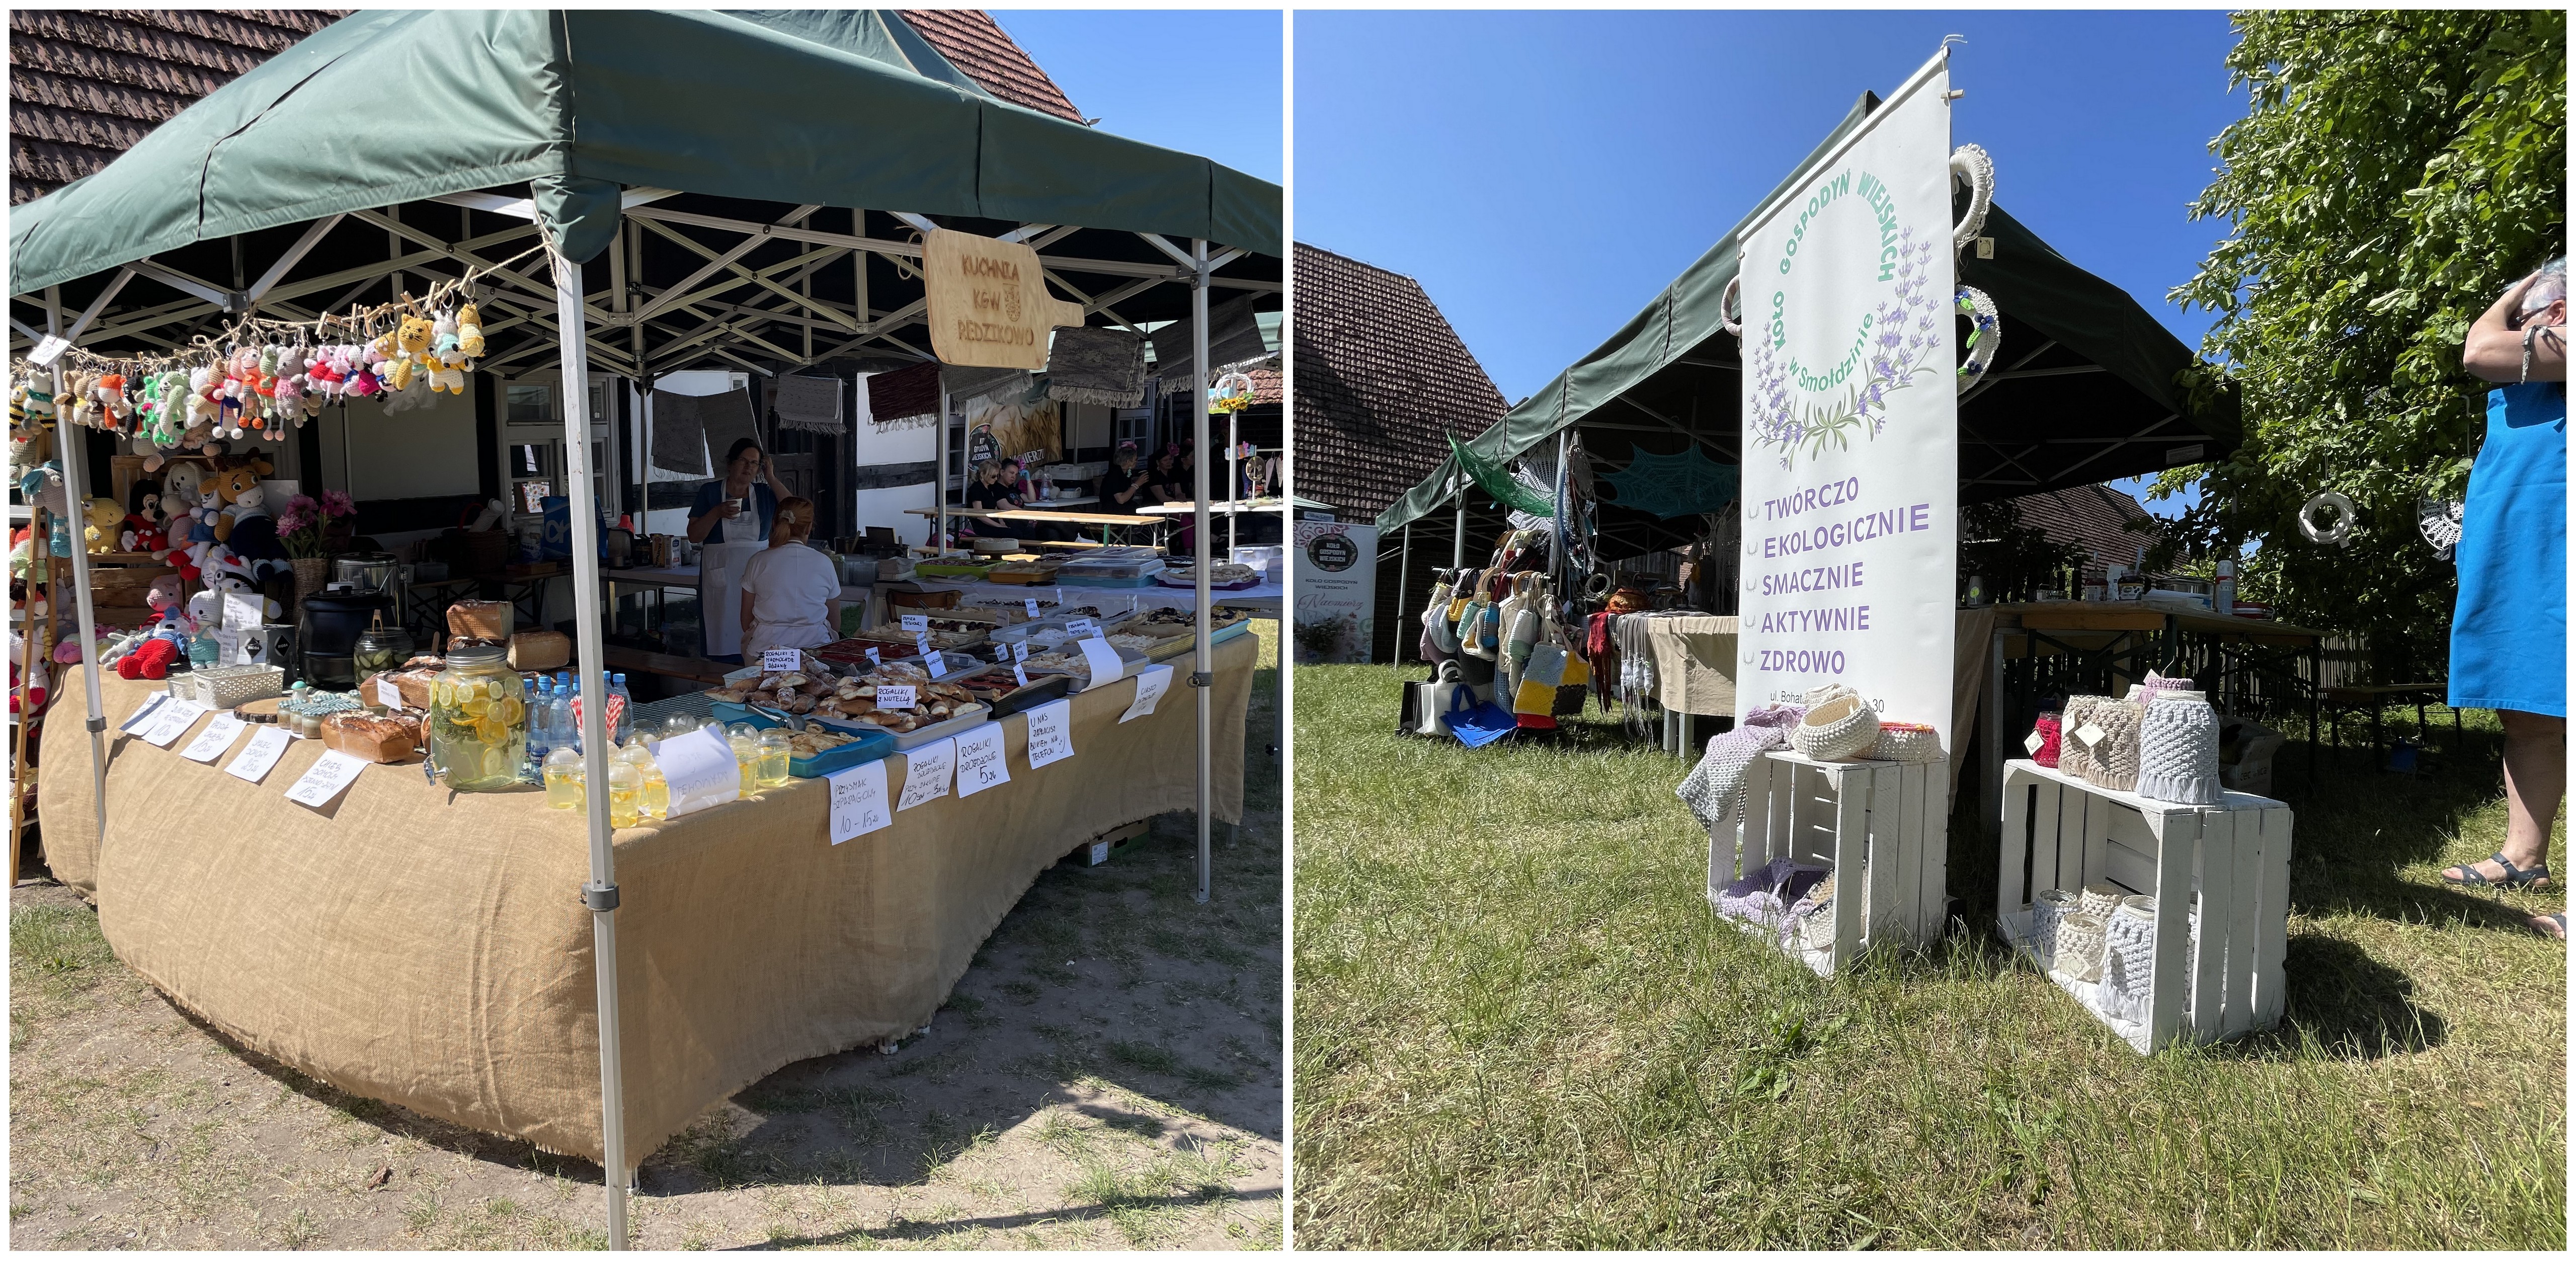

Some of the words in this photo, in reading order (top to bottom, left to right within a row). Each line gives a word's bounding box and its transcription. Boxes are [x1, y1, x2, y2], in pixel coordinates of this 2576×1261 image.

[961, 253, 1019, 281] KUCHNIA
[1773, 291, 1786, 351] KOŁO
[1780, 168, 1851, 275] GOSPODYŃ
[1857, 171, 1898, 282] WIEJSKICH
[973, 288, 1001, 311] KGW
[1789, 357, 1800, 376] w
[1799, 313, 1873, 392] Smołdzinie
[1764, 477, 1859, 521] TWÓRCZO
[1764, 504, 1929, 559] EKOLOGICZNIE
[1762, 562, 1863, 596] SMACZNIE
[1761, 605, 1870, 633] AKTYWNIE
[1760, 650, 1845, 674] ZDROWO
[884, 696, 911, 704] NUTELLĄ
[1770, 690, 1779, 701] ul.
[1781, 691, 1803, 704] Bohat
[1030, 717, 1035, 728] U
[1037, 713, 1048, 725] NAS
[961, 738, 991, 758] ROGALIKI
[1051, 735, 1058, 743] NA
[1031, 747, 1054, 761] TELEFON
